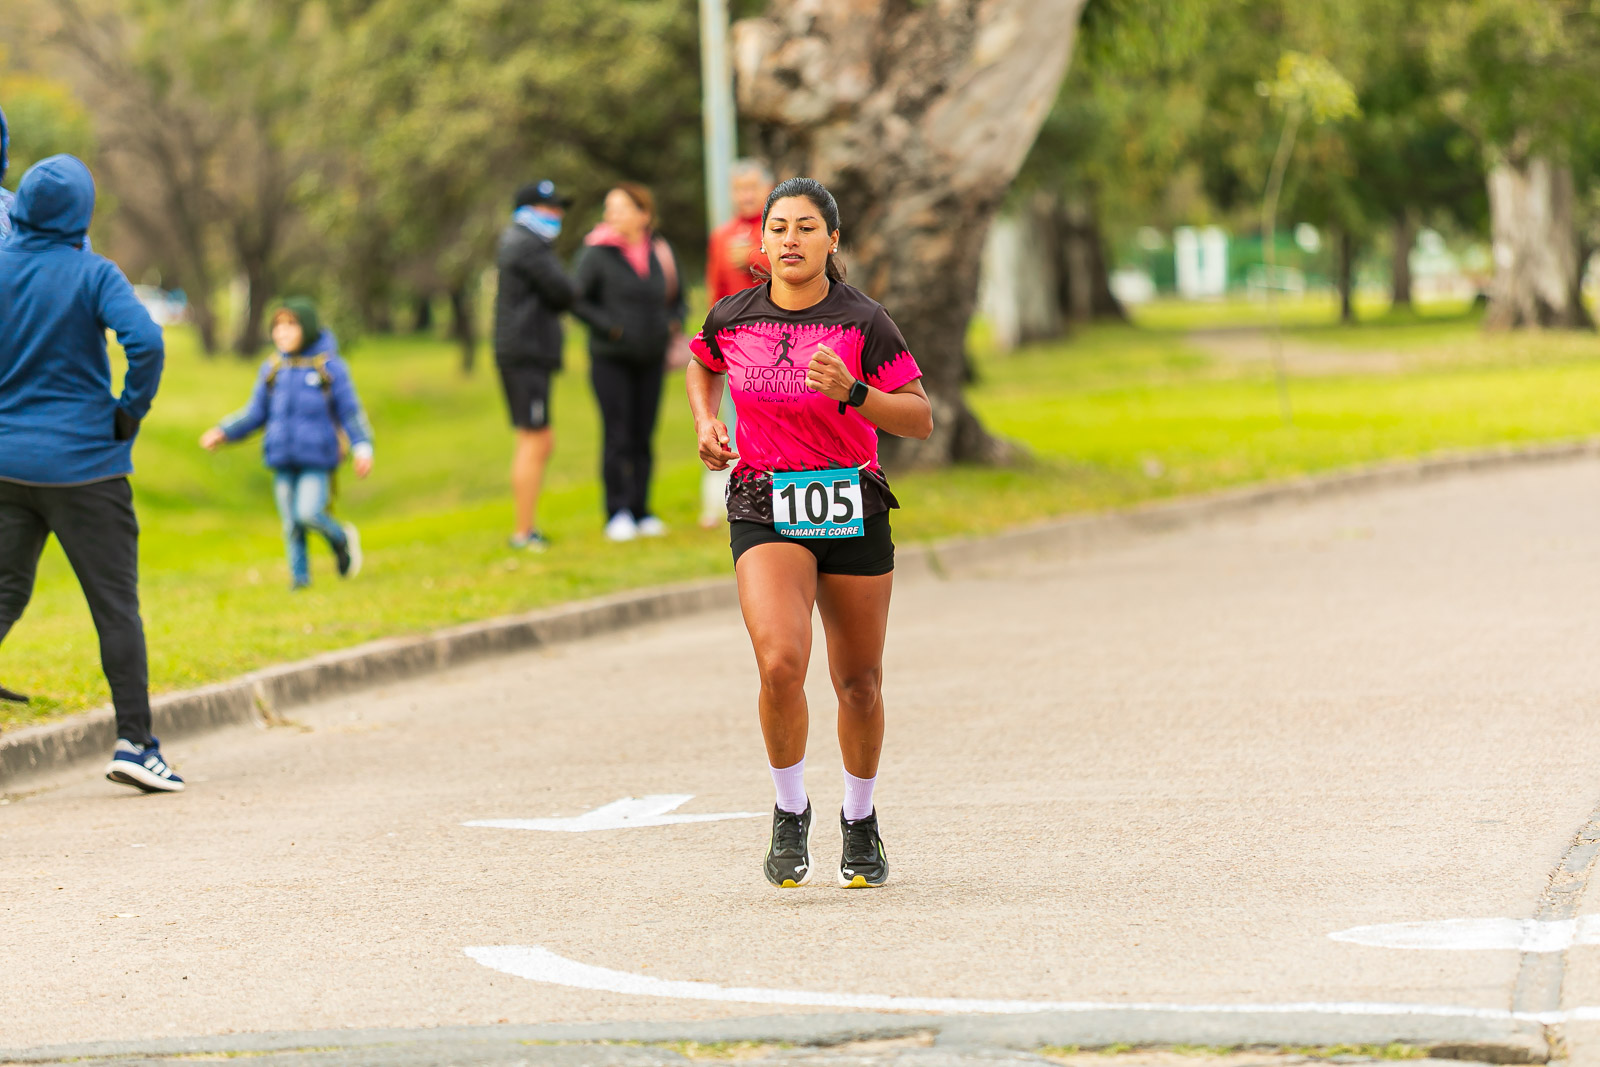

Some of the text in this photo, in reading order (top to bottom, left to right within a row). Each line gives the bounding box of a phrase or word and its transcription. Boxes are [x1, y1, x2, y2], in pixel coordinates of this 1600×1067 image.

[745, 367, 806, 380] WOMA
[780, 479, 854, 526] 105
[780, 526, 859, 537] DIAMANTE CORRE
